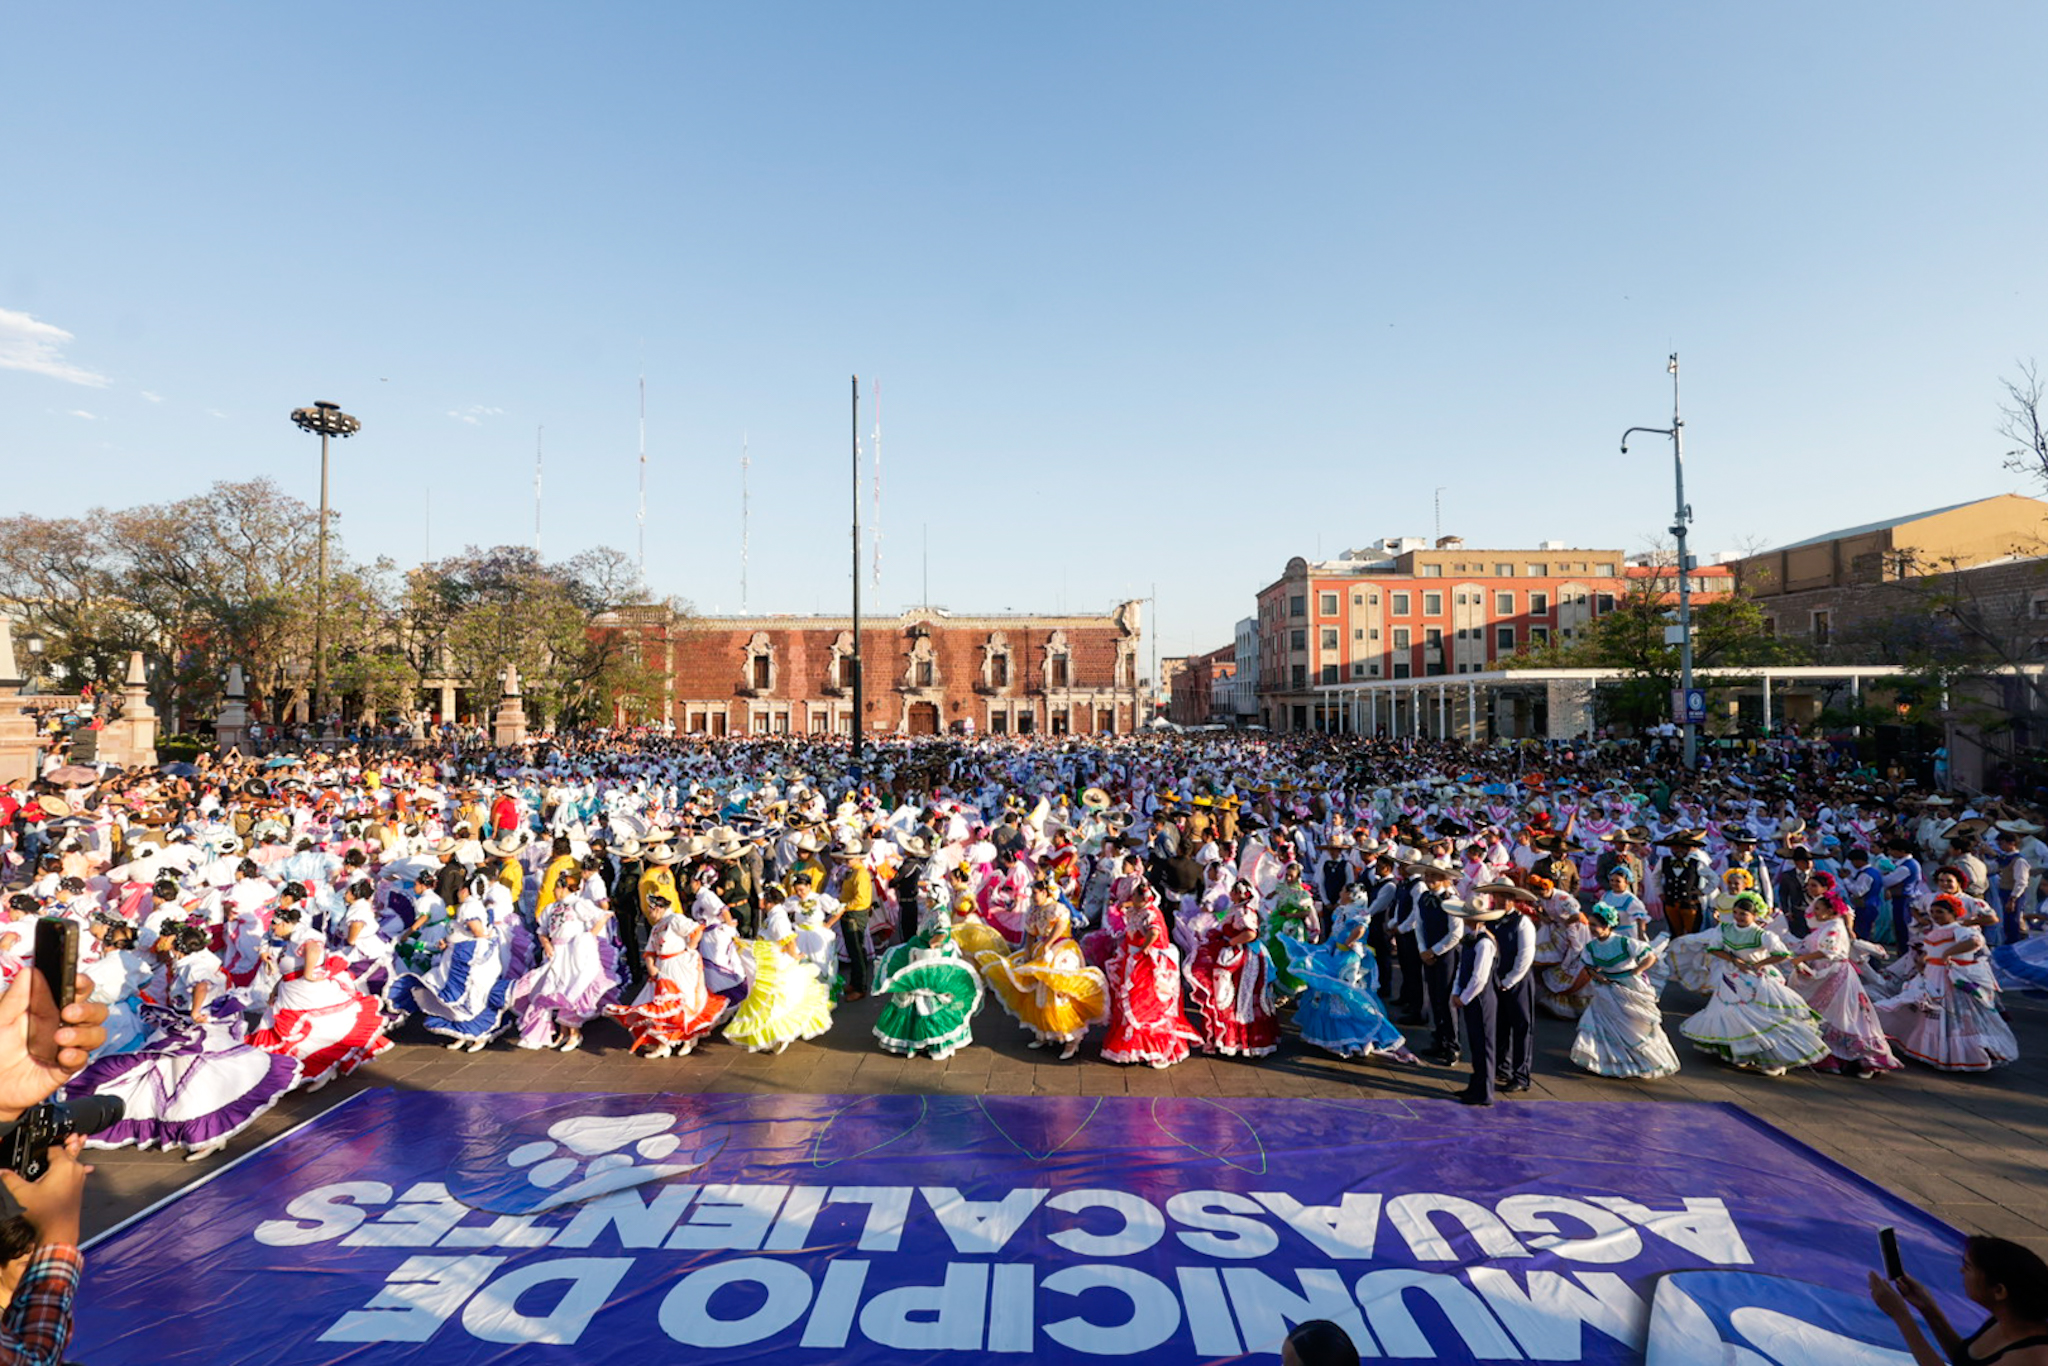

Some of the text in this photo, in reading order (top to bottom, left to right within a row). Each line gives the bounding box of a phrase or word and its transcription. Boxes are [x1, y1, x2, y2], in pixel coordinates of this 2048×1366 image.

[254, 1181, 1754, 1267] AGUASCALIENTES
[316, 1255, 1648, 1361] MUNICIPIO DE
